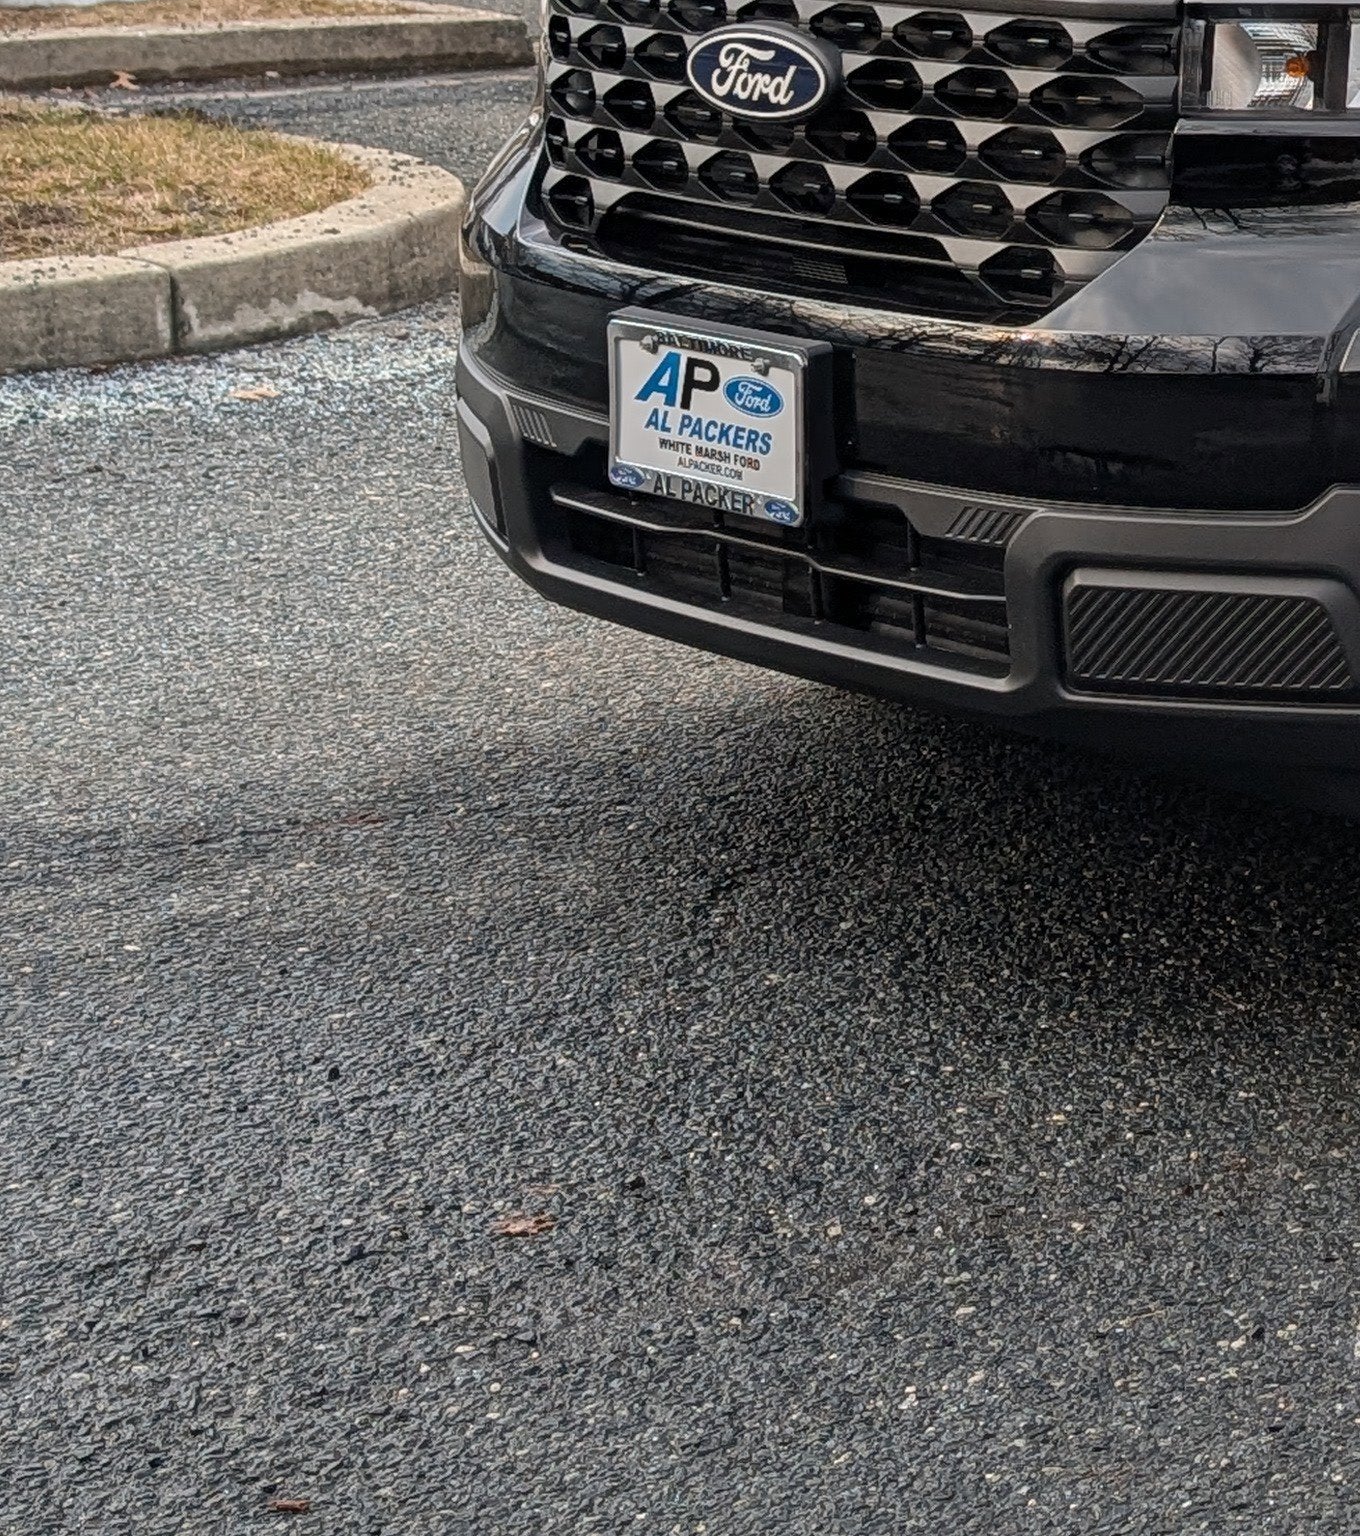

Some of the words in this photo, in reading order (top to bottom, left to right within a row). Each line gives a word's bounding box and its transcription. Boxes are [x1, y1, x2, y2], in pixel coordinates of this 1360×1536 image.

[711, 42, 798, 106] Ford
[634, 351, 720, 411] AP
[734, 381, 773, 413] Ford
[644, 407, 672, 434] AL
[678, 413, 772, 456] PACKERS
[659, 436, 692, 456] WHITE
[694, 445, 731, 464] MARSH
[733, 454, 761, 471] FORD
[653, 473, 676, 498] AL
[681, 480, 755, 516] PACKER
